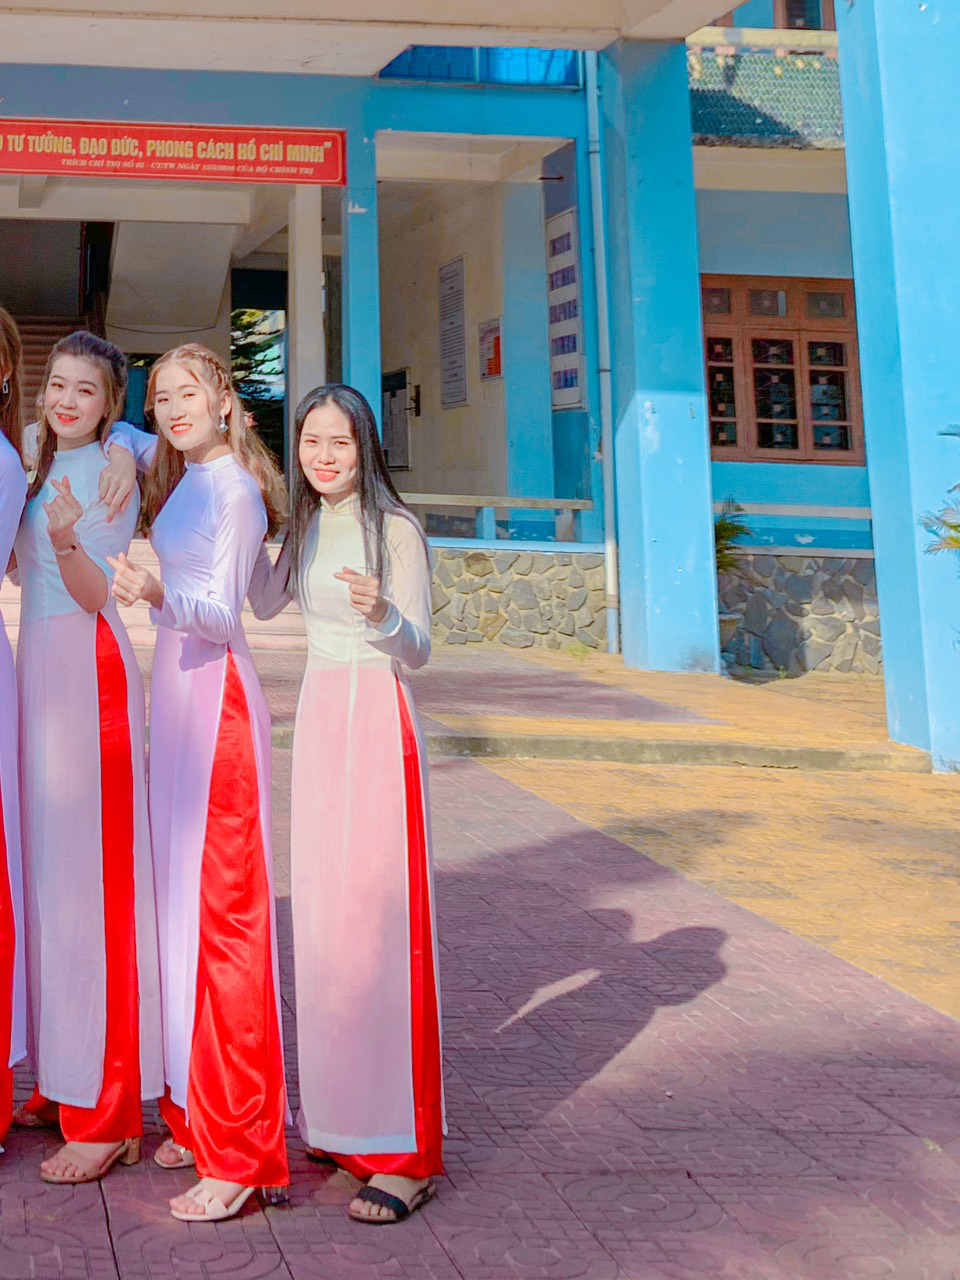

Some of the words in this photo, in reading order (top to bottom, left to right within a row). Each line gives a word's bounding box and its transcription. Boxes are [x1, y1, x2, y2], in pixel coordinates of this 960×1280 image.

[6, 133, 26, 153] TƯ
[80, 136, 108, 158] ĐẠO
[146, 139, 194, 159] PHONG
[196, 138, 234, 160] CÁCH
[259, 140, 284, 162] CHÍ
